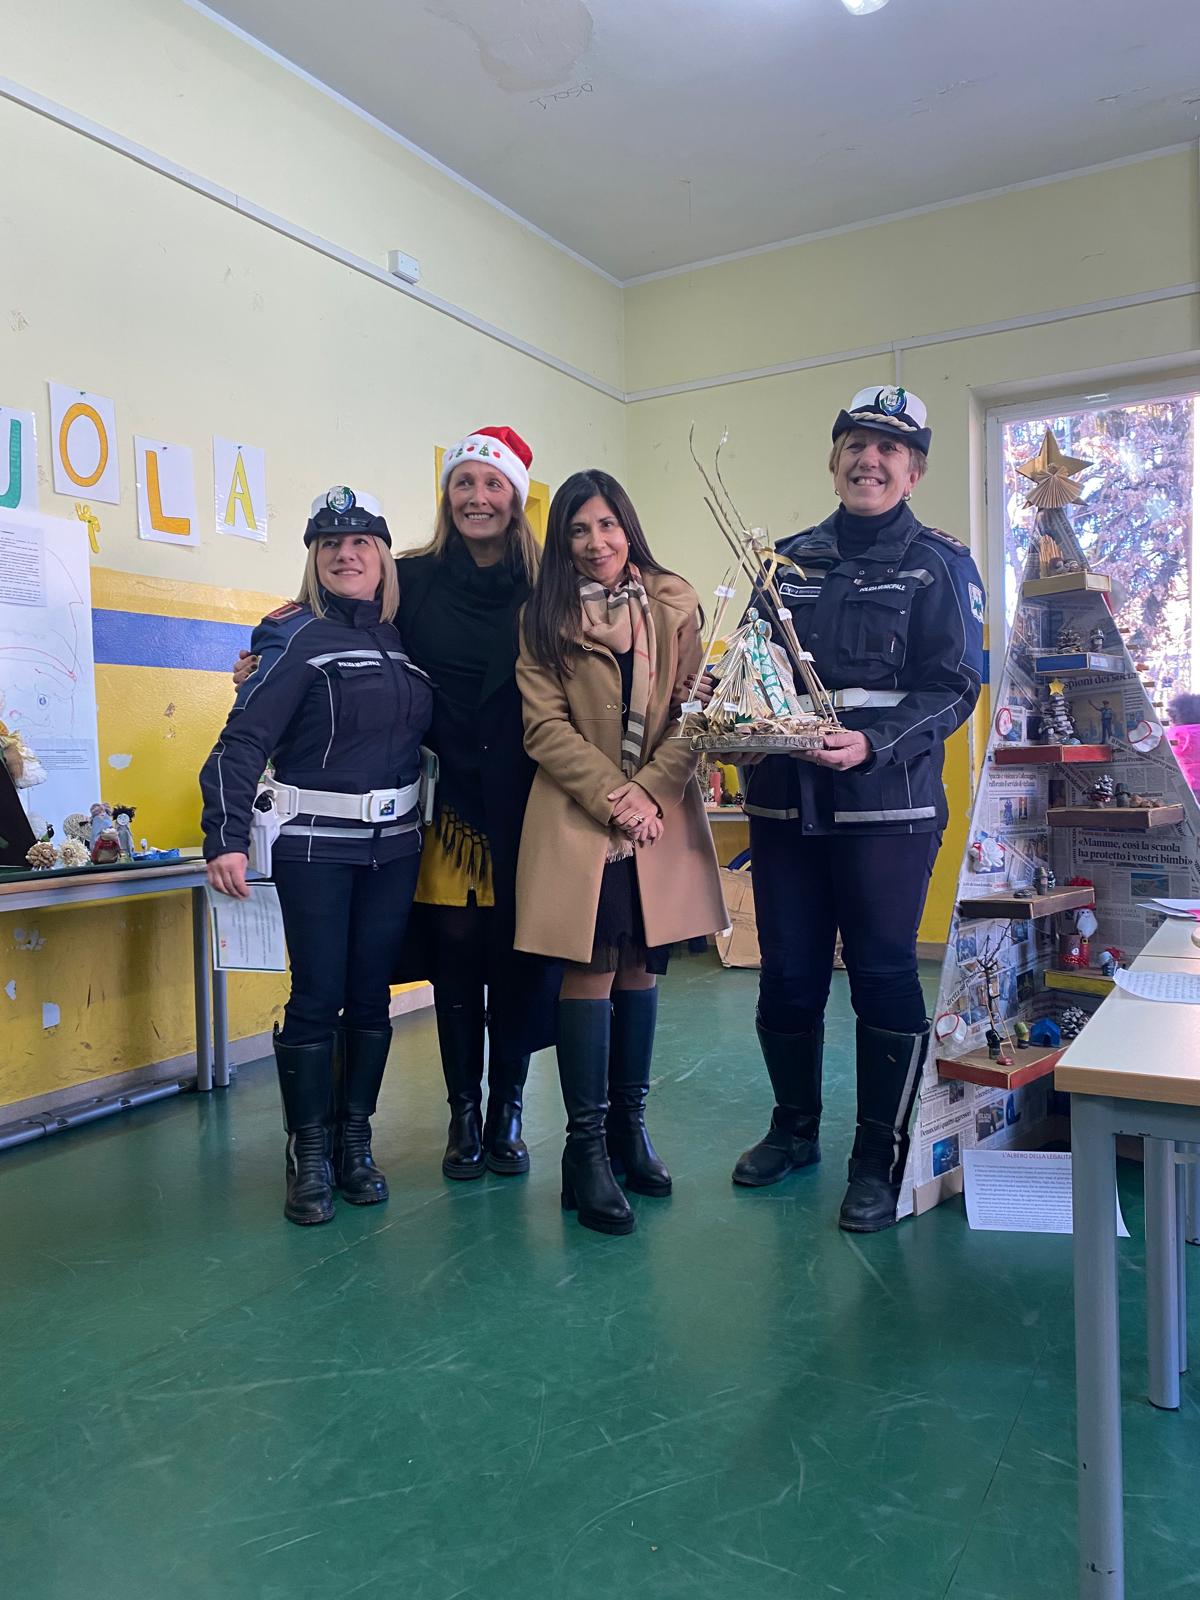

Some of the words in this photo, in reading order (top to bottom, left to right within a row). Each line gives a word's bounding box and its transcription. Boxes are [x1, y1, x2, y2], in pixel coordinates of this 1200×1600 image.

[1141, 841, 1150, 851] la
[1151, 843, 1181, 853] scuola
[1078, 848, 1090, 858] ha
[1090, 849, 1126, 861] protetto
[1127, 851, 1131, 861] i
[1132, 853, 1159, 863] vostri
